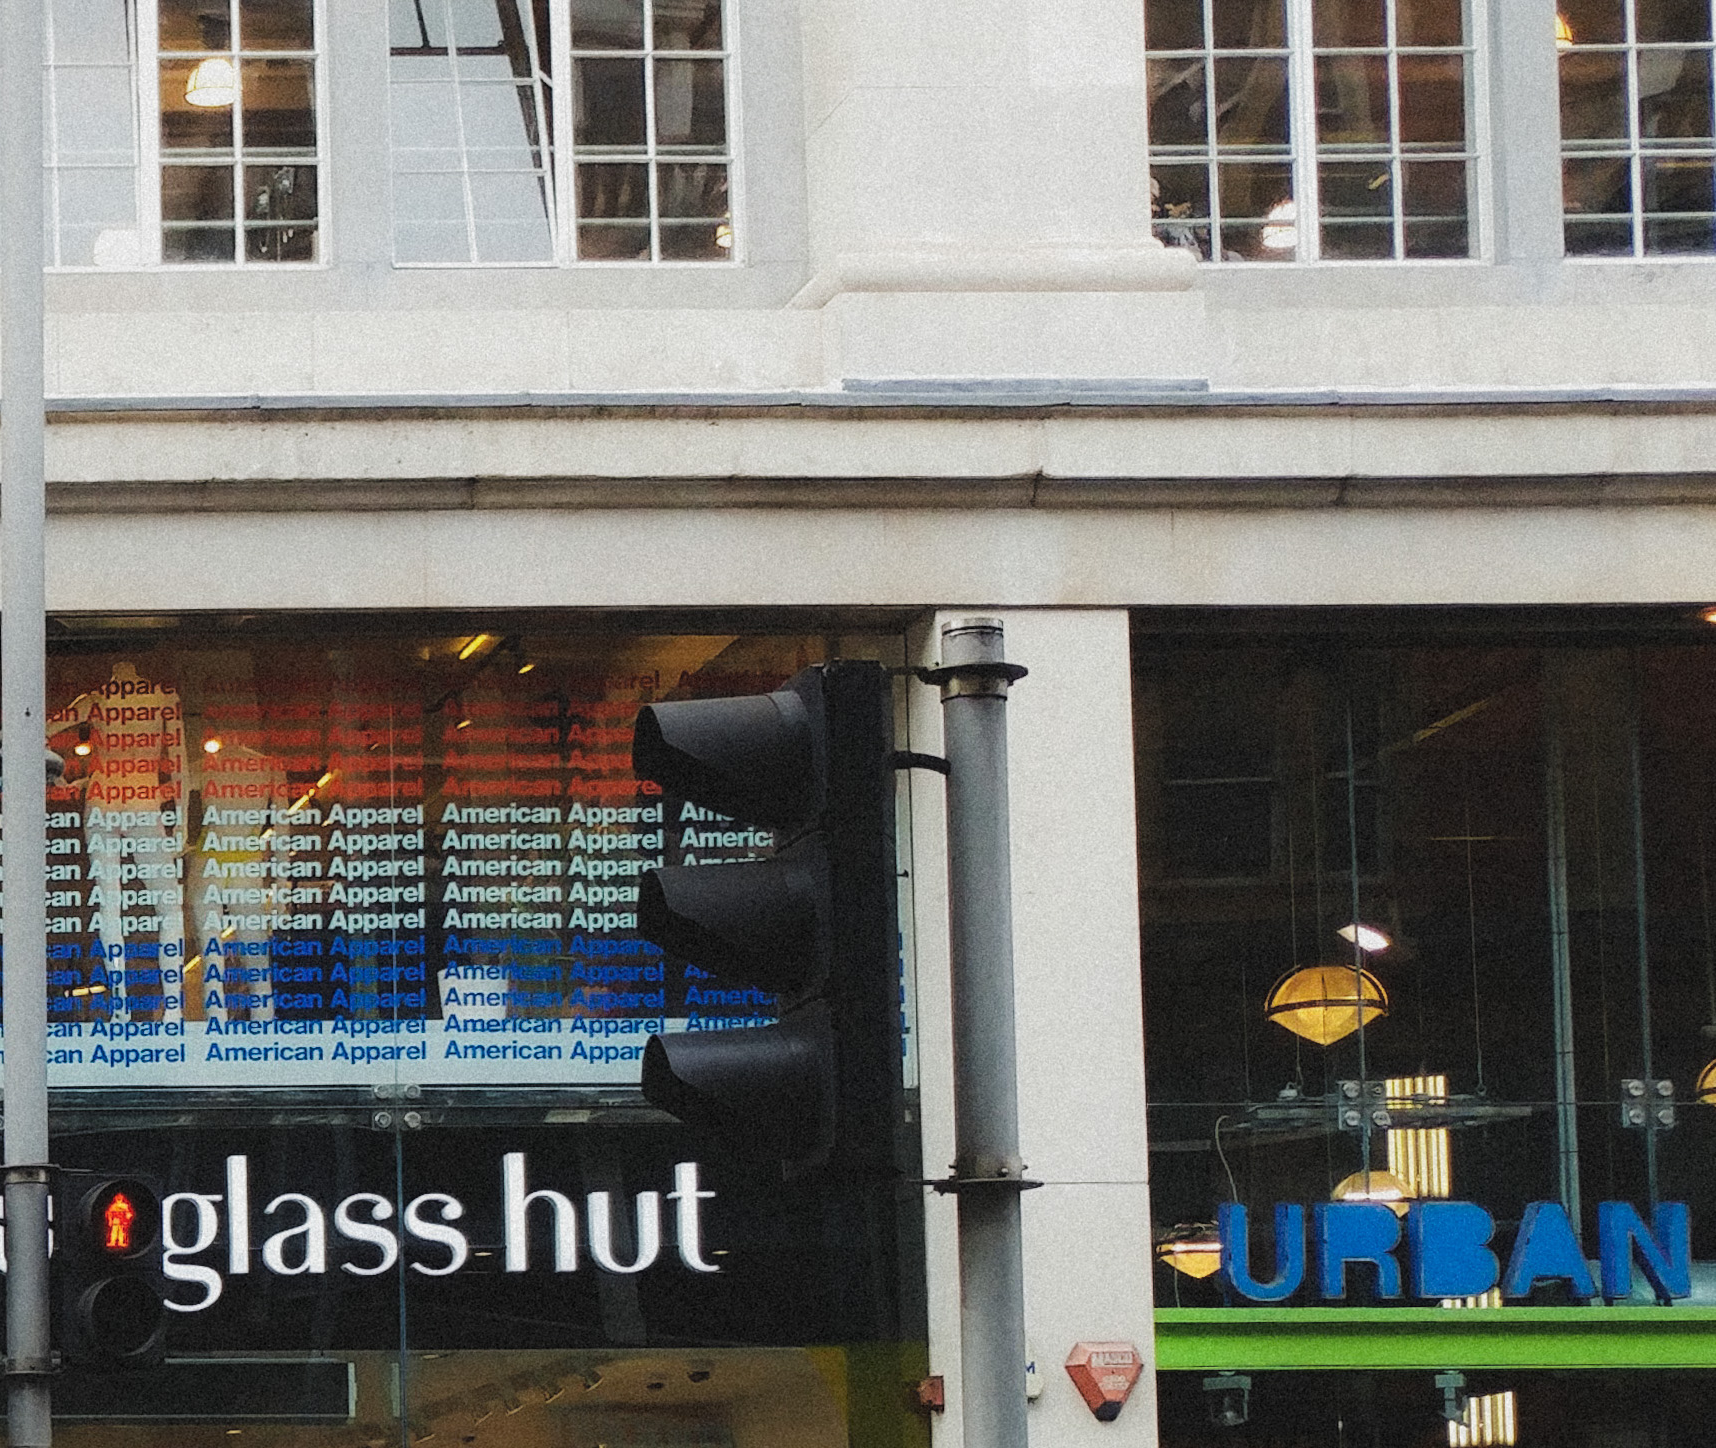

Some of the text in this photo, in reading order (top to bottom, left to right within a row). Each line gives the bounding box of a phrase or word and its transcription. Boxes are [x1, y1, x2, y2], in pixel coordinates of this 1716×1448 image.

[86, 807, 183, 831] Apparel
[202, 803, 424, 828] American Apparel
[441, 802, 561, 824] American
[567, 802, 663, 827] Apparel
[87, 833, 183, 857] Apparel
[202, 829, 424, 854] American Apparel
[441, 828, 663, 853] American Apparel
[203, 856, 424, 880] American Apparel
[442, 855, 561, 876] American
[203, 882, 425, 907] American Apparel
[442, 881, 561, 903] American
[203, 909, 425, 933] American Apparel
[442, 908, 561, 929] American
[89, 939, 184, 962] Apparel
[204, 935, 425, 959] American Apparel
[443, 934, 562, 955] American
[89, 965, 184, 988] Apparel
[204, 962, 425, 985] American Apparel
[443, 961, 562, 981] American
[569, 961, 664, 985] Apparel
[90, 991, 185, 1015] Apparel
[204, 988, 426, 1012] American Apparel
[443, 987, 664, 1011] American Apparel
[90, 1018, 185, 1041] Apparel
[205, 1015, 426, 1038] American Apparel
[444, 1014, 664, 1038] American Apparel
[91, 1044, 185, 1067] Apparel
[205, 1041, 426, 1064] American Apparel
[444, 1040, 562, 1060] American
[502, 1152, 721, 1274] hut
[1219, 1200, 1693, 1302] URBAN
